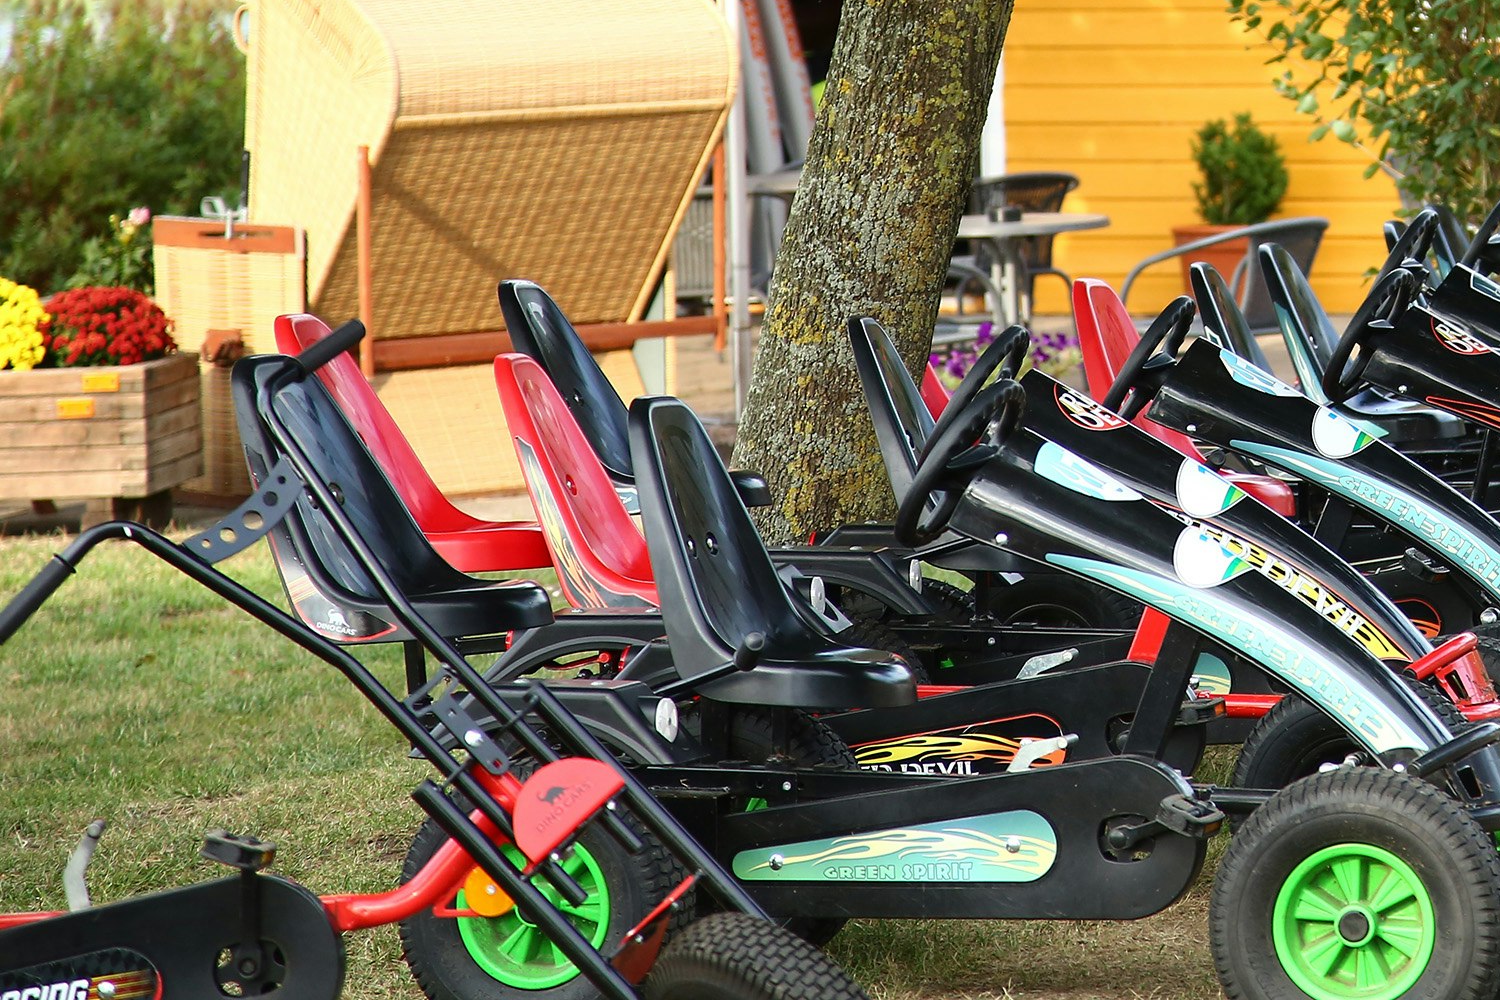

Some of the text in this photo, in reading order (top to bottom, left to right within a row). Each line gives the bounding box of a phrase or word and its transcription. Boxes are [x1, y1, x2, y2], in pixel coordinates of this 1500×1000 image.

[1338, 475, 1430, 530] GREEN
[1173, 594, 1374, 726] GREEN SPIRIT
[823, 861, 974, 881] GREEN SPIRIT
